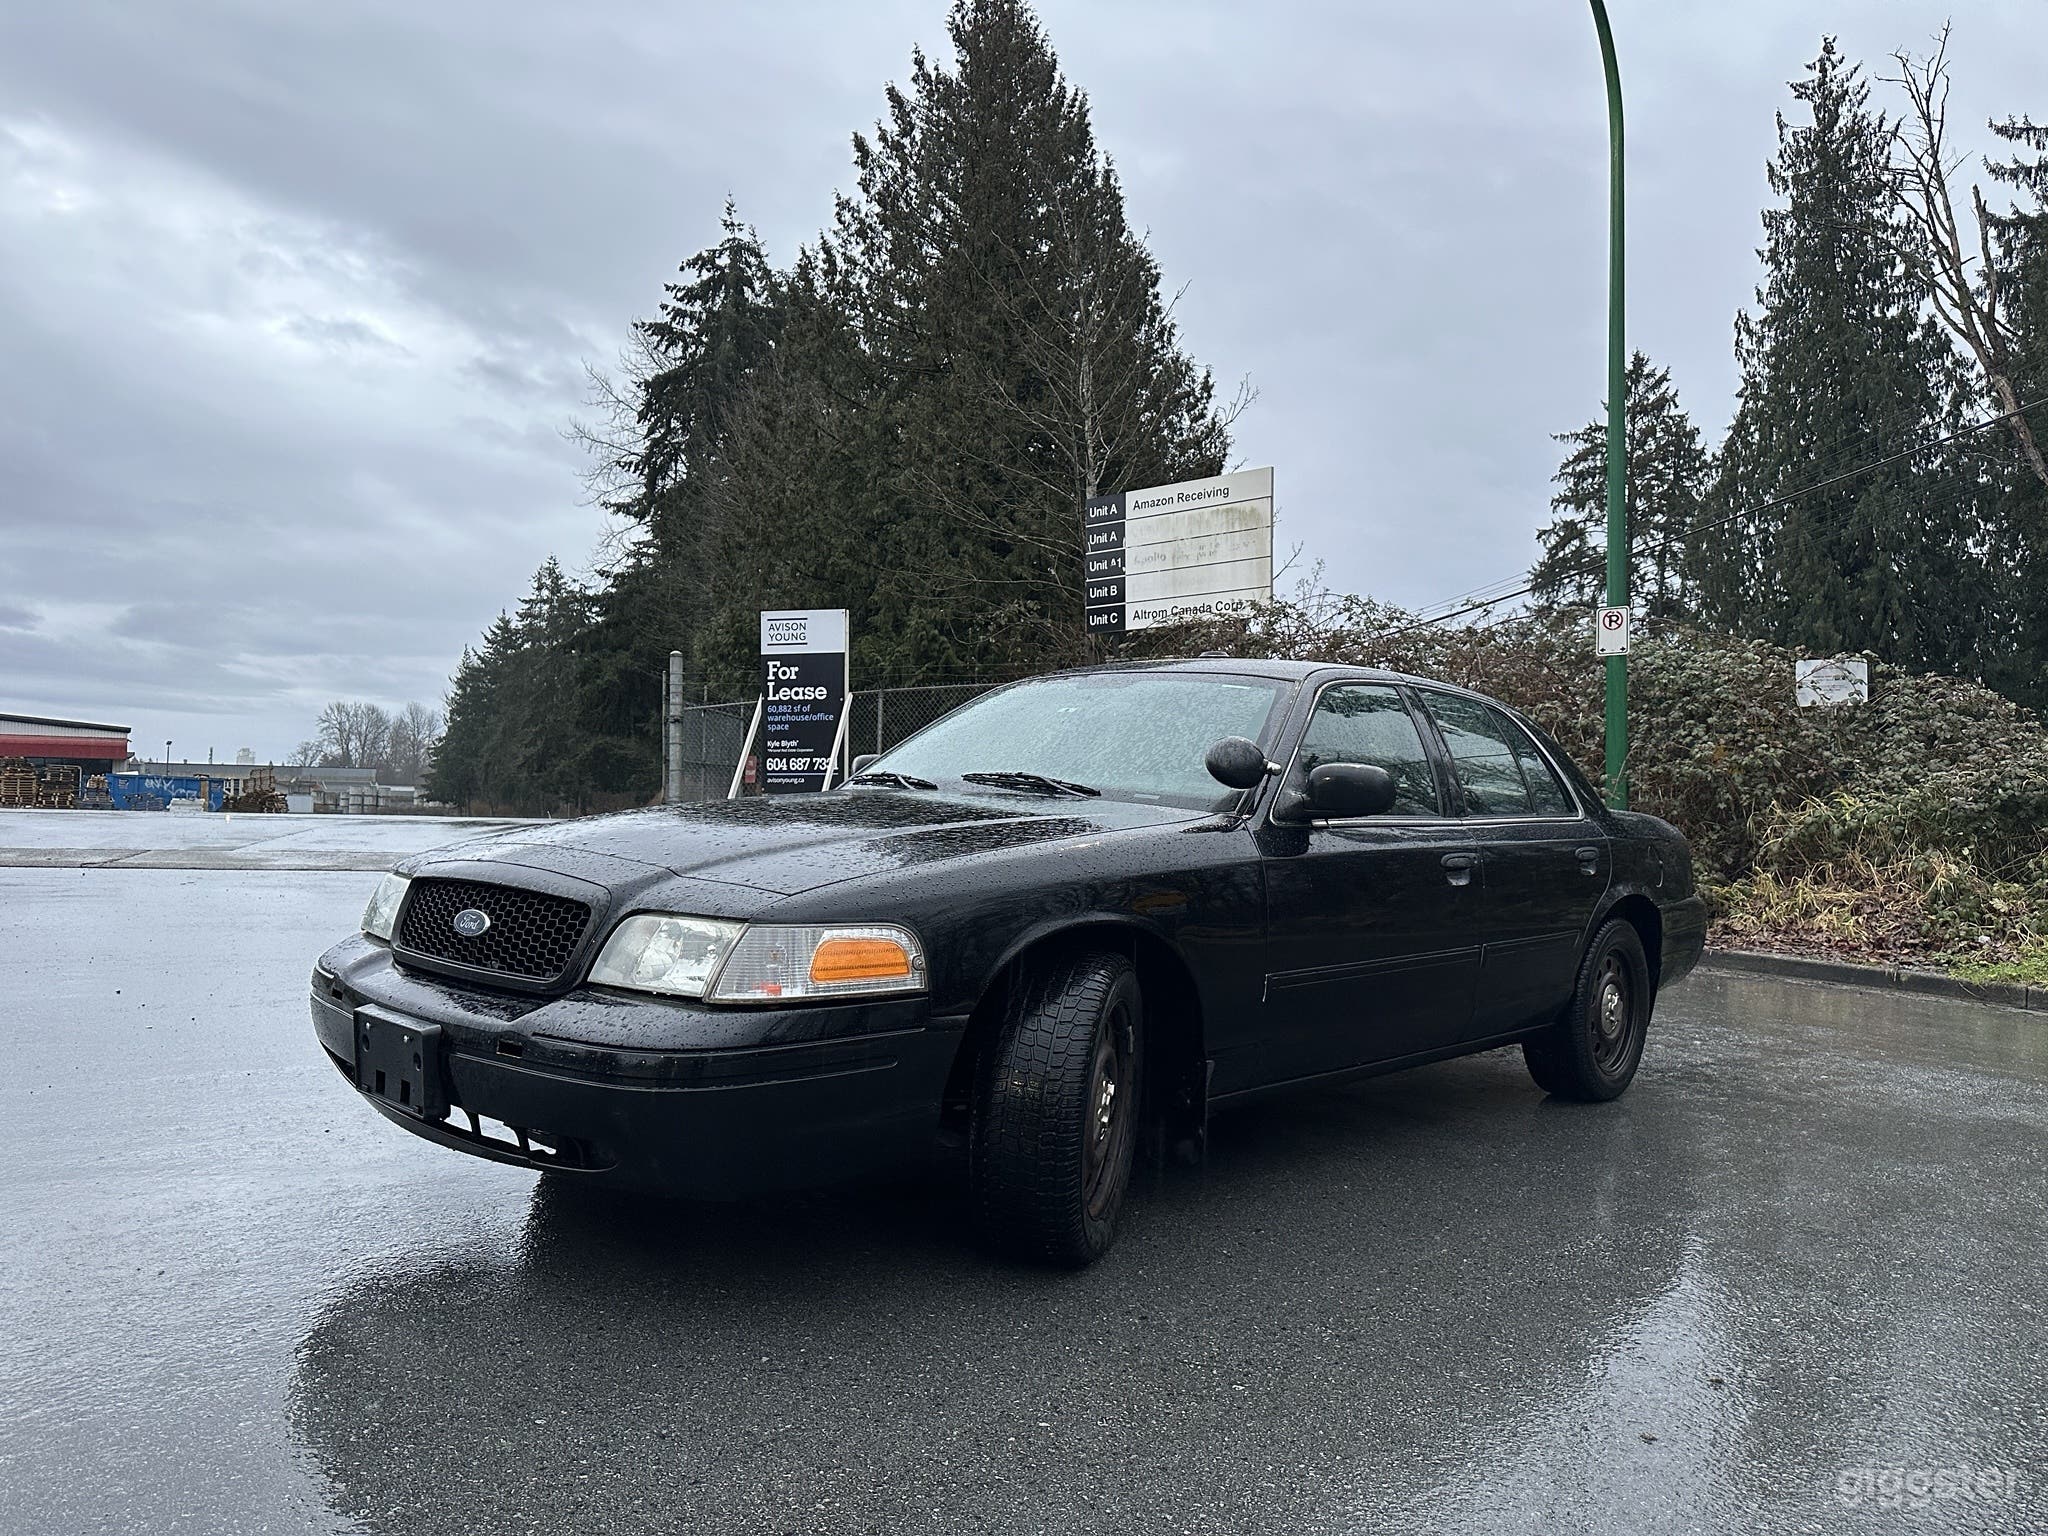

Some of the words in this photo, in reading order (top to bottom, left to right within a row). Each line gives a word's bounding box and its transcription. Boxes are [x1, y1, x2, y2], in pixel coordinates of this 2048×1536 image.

[1133, 496, 1174, 511] Amazon
[1177, 486, 1230, 503] Receiving
[1089, 505, 1108, 518] Unit
[1110, 503, 1118, 515] A
[1089, 532, 1108, 545] Unit
[1110, 530, 1118, 542] A
[1089, 559, 1108, 572] Unit
[1089, 586, 1108, 599] Unit
[1110, 584, 1118, 596] B
[1089, 613, 1108, 626] Unit
[1110, 612, 1118, 624] C
[1133, 609, 1167, 621] Altrom
[1171, 603, 1212, 616] Canada
[768, 622, 807, 632] AVISON
[768, 632, 807, 642] YOUNG
[767, 661, 799, 680] For
[767, 681, 828, 700] Lease
[767, 705, 792, 713] 60,882
[793, 704, 800, 713] sf
[802, 704, 811, 713] of
[767, 713, 834, 722] warehouse/office
[767, 724, 789, 732] space
[767, 740, 780, 748] Kyle
[766, 758, 788, 771] 604
[789, 757, 811, 771] 687
[460, 913, 480, 929] Ford
